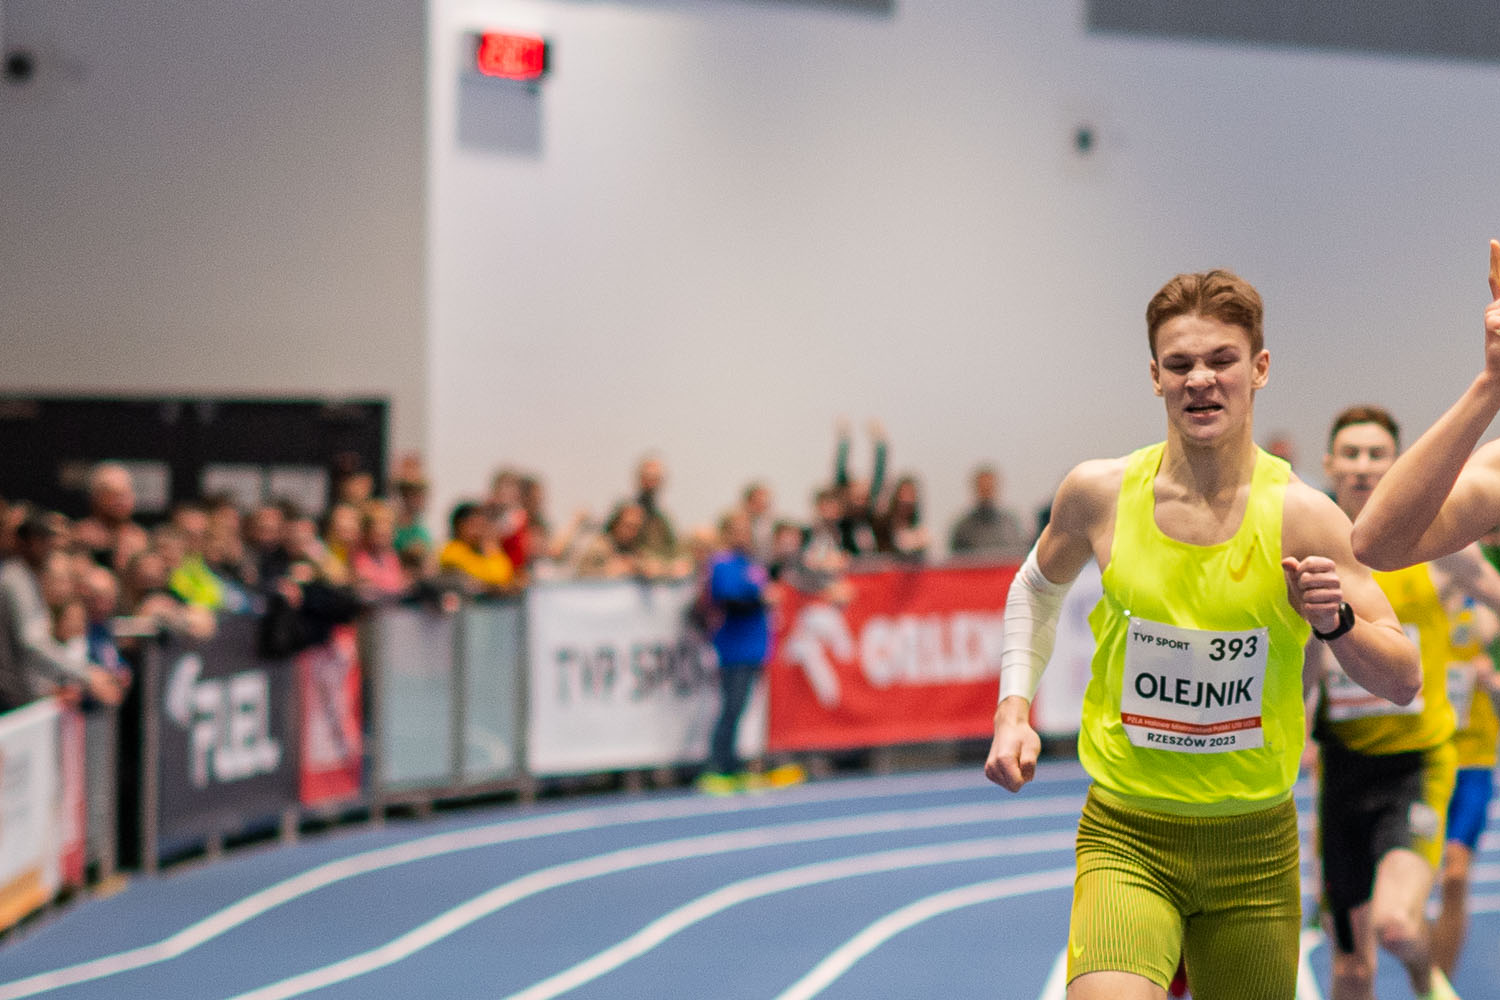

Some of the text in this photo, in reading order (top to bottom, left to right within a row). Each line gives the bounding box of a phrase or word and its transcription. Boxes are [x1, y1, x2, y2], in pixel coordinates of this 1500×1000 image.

[1133, 632, 1258, 661] TVP SPORT 393
[1134, 672, 1255, 709] OLEJNIK
[1147, 732, 1236, 747] RZESZÓW 2023
